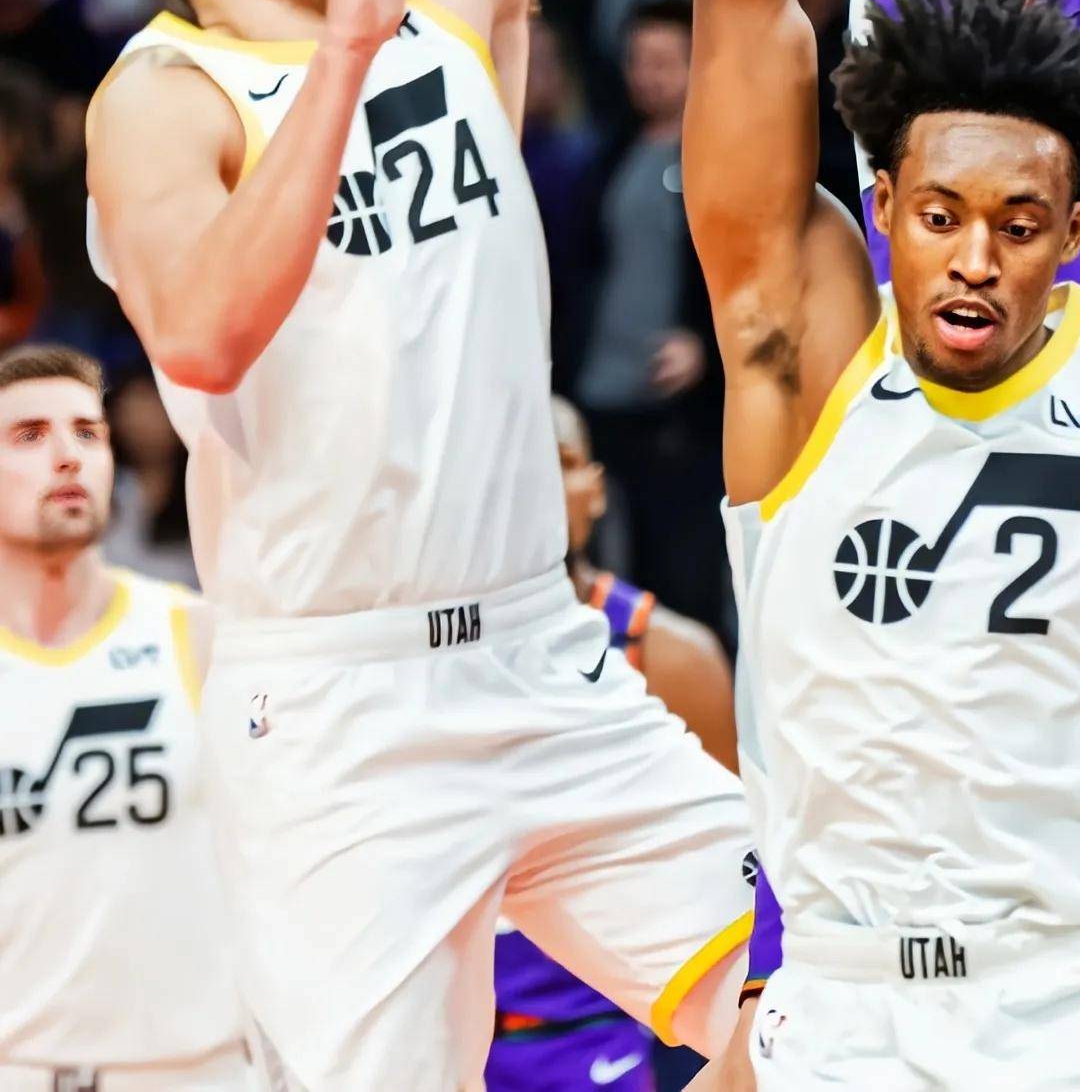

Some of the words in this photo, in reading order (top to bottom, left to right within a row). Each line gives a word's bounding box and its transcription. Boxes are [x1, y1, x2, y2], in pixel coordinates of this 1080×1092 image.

[382, 118, 499, 244] 24
[987, 515, 1058, 635] 2
[428, 602, 481, 648] UTAH
[73, 745, 170, 828] 25
[900, 935, 967, 979] UTAH
